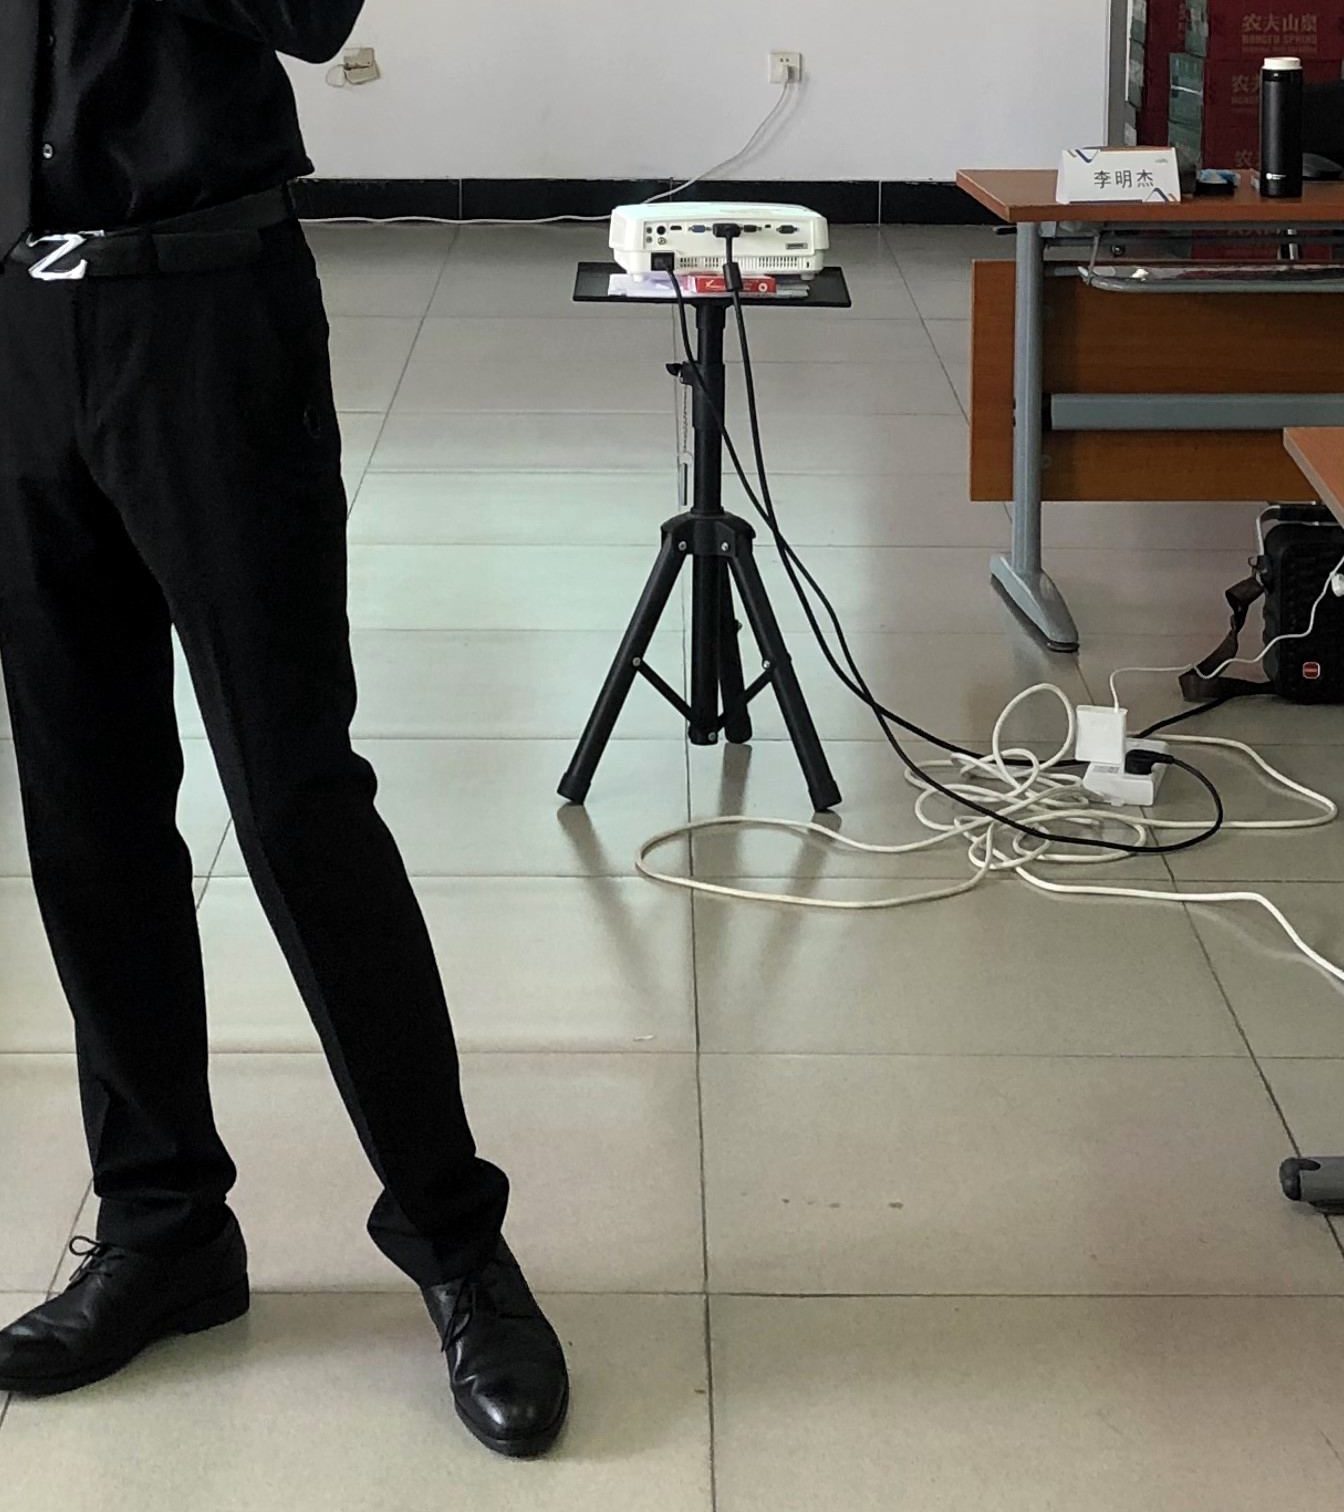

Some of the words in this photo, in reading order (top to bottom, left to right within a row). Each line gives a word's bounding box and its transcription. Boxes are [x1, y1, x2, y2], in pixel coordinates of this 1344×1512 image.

[1241, 13, 1317, 33] 农夫山泉
[1093, 168, 1155, 190] 李明杰
